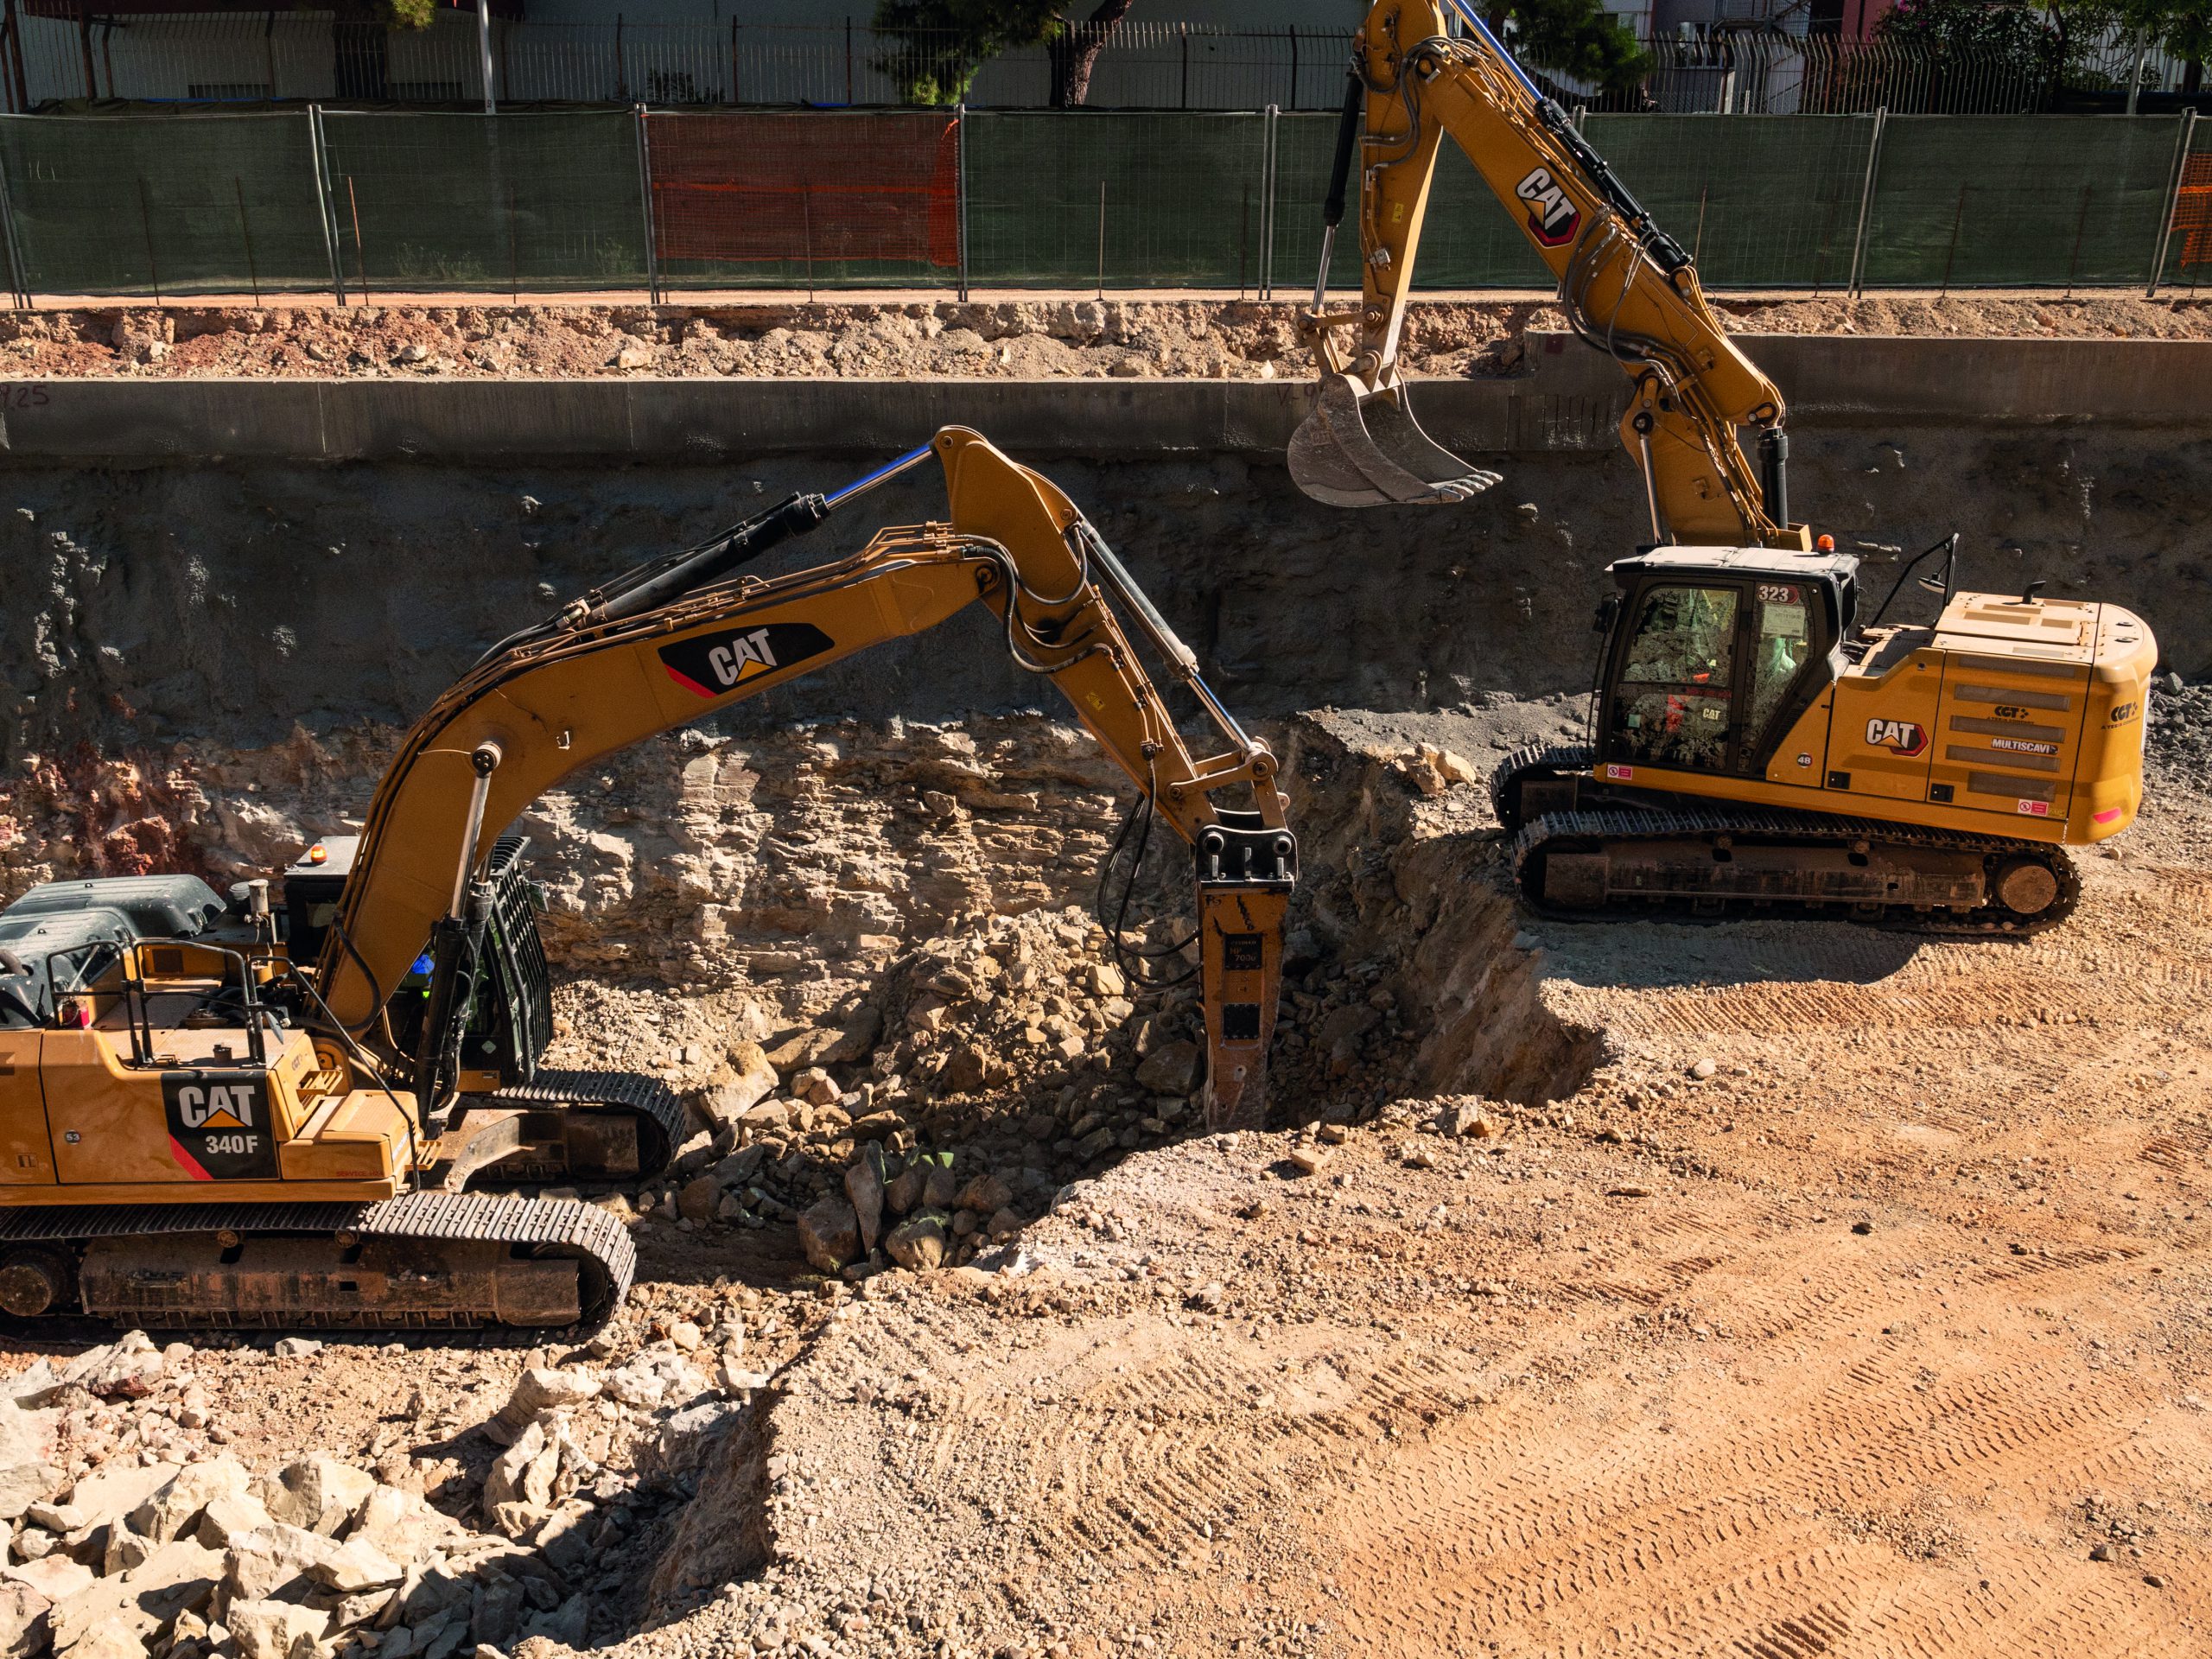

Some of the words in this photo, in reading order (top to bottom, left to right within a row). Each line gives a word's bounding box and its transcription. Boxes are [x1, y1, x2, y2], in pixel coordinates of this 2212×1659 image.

[1517, 168, 1576, 230] CAT
[1758, 585, 1789, 602] 323
[709, 627, 778, 686] CAT
[1702, 708, 1721, 721] CAT
[1994, 705, 2019, 718] CGT
[2111, 702, 2131, 721] CGT
[1866, 719, 1916, 748] CAT
[1992, 738, 2050, 754] MULTISCAVI
[1797, 756, 1812, 765] 48
[178, 1085, 256, 1128] CAT
